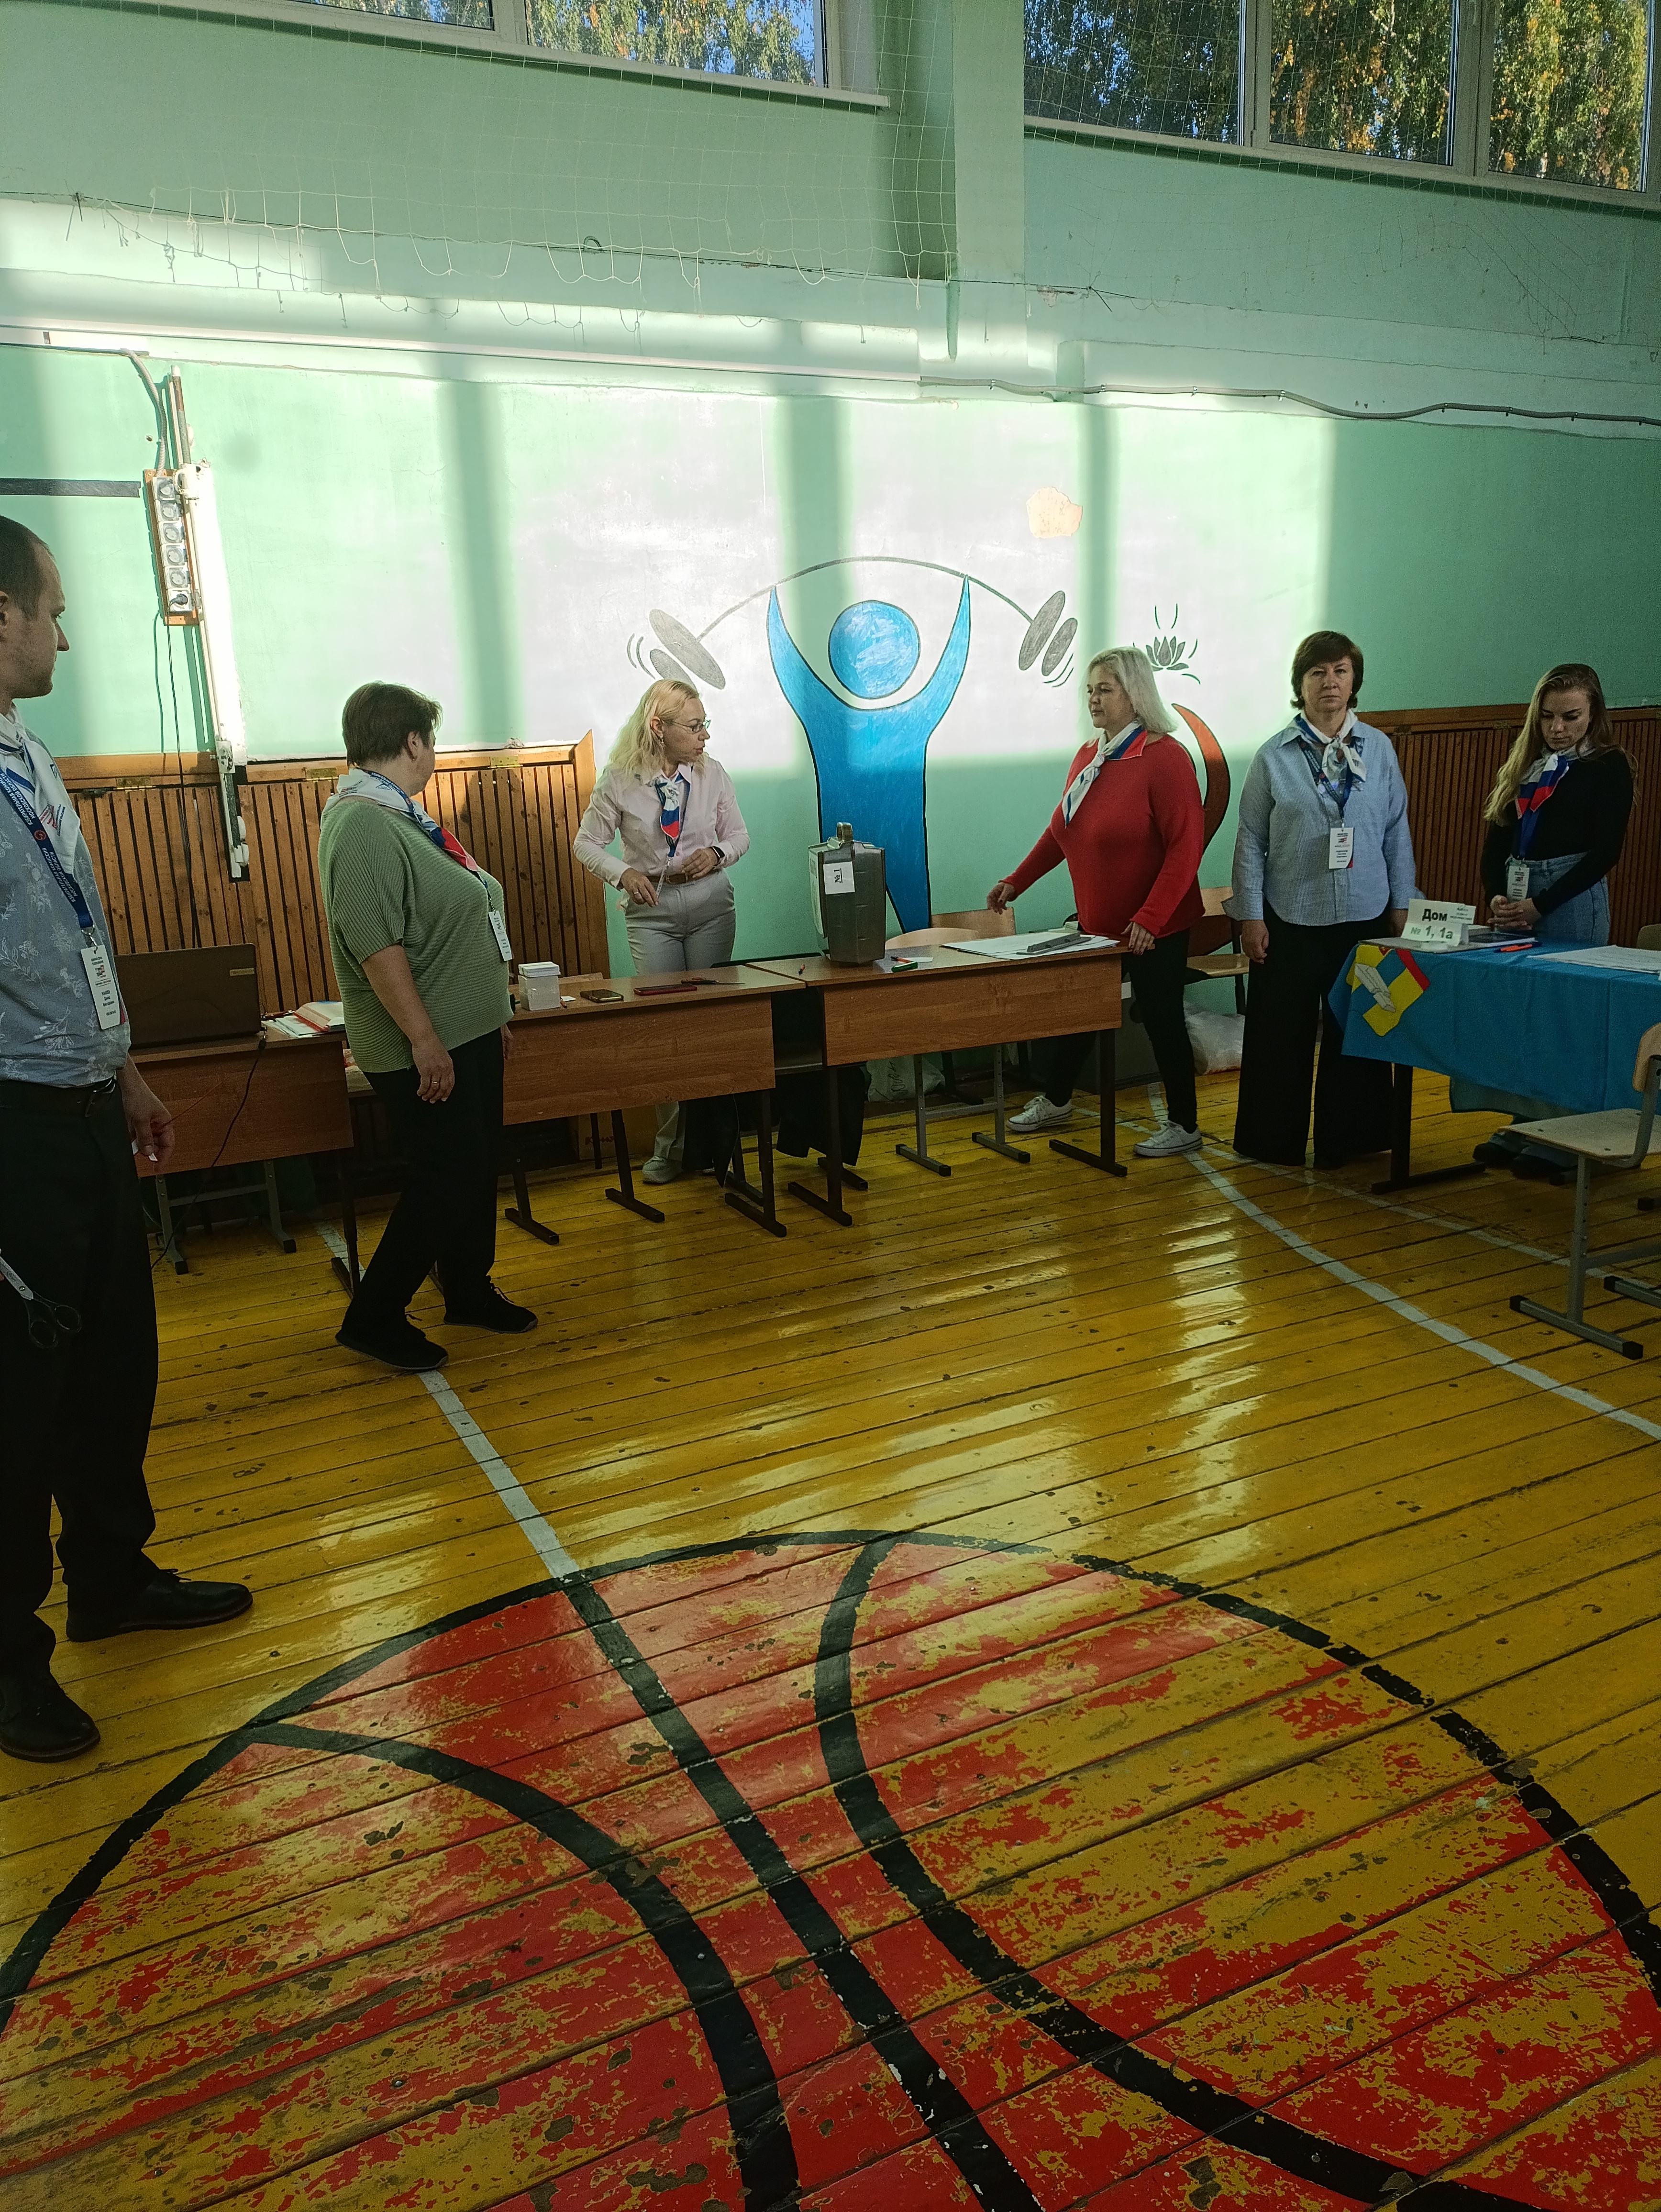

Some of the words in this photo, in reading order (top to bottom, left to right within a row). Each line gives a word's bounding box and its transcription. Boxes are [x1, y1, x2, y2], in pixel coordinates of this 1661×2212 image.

[0, 773, 17, 791] ОБЛАСТИ
[0, 776, 12, 793] КОМИС
[10, 793, 33, 826] ИЗБИРАТЕЛЬНАЯ
[14, 790, 36, 819] МОСКОВСКОЙ
[42, 848, 56, 871] КОМИССИЯ
[50, 852, 61, 871] ОБЛАСТИ
[54, 871, 76, 903] ИЗБИРАТЕЛЬНАЯ
[58, 871, 78, 896] МОСКОВСКОЙ
[834, 875, 841, 884] №
[1422, 908, 1448, 921] Дом
[1425, 926, 1434, 939] 1,
[1440, 927, 1453, 939] 1а
